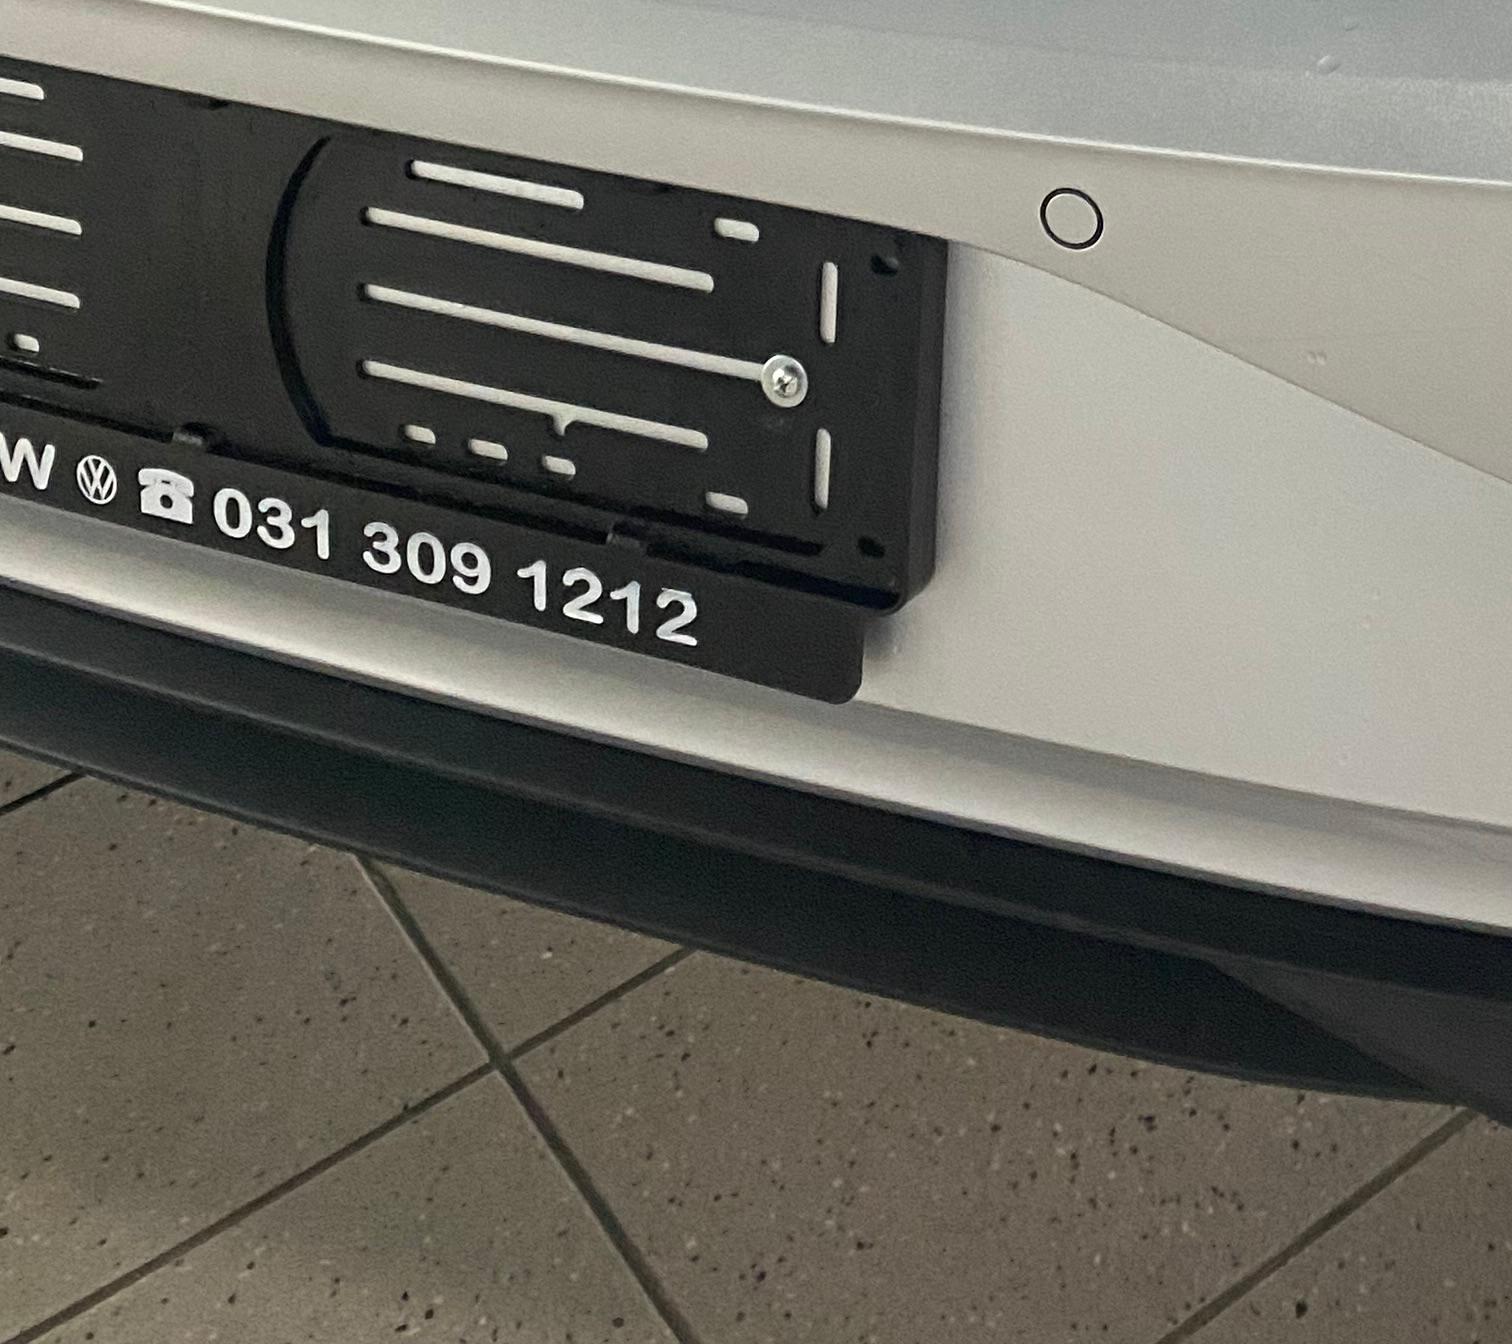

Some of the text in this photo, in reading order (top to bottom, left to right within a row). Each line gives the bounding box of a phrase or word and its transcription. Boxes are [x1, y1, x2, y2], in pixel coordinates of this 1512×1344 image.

[213, 487, 330, 560] 031
[362, 521, 492, 595] 309
[516, 560, 699, 647] 1212
